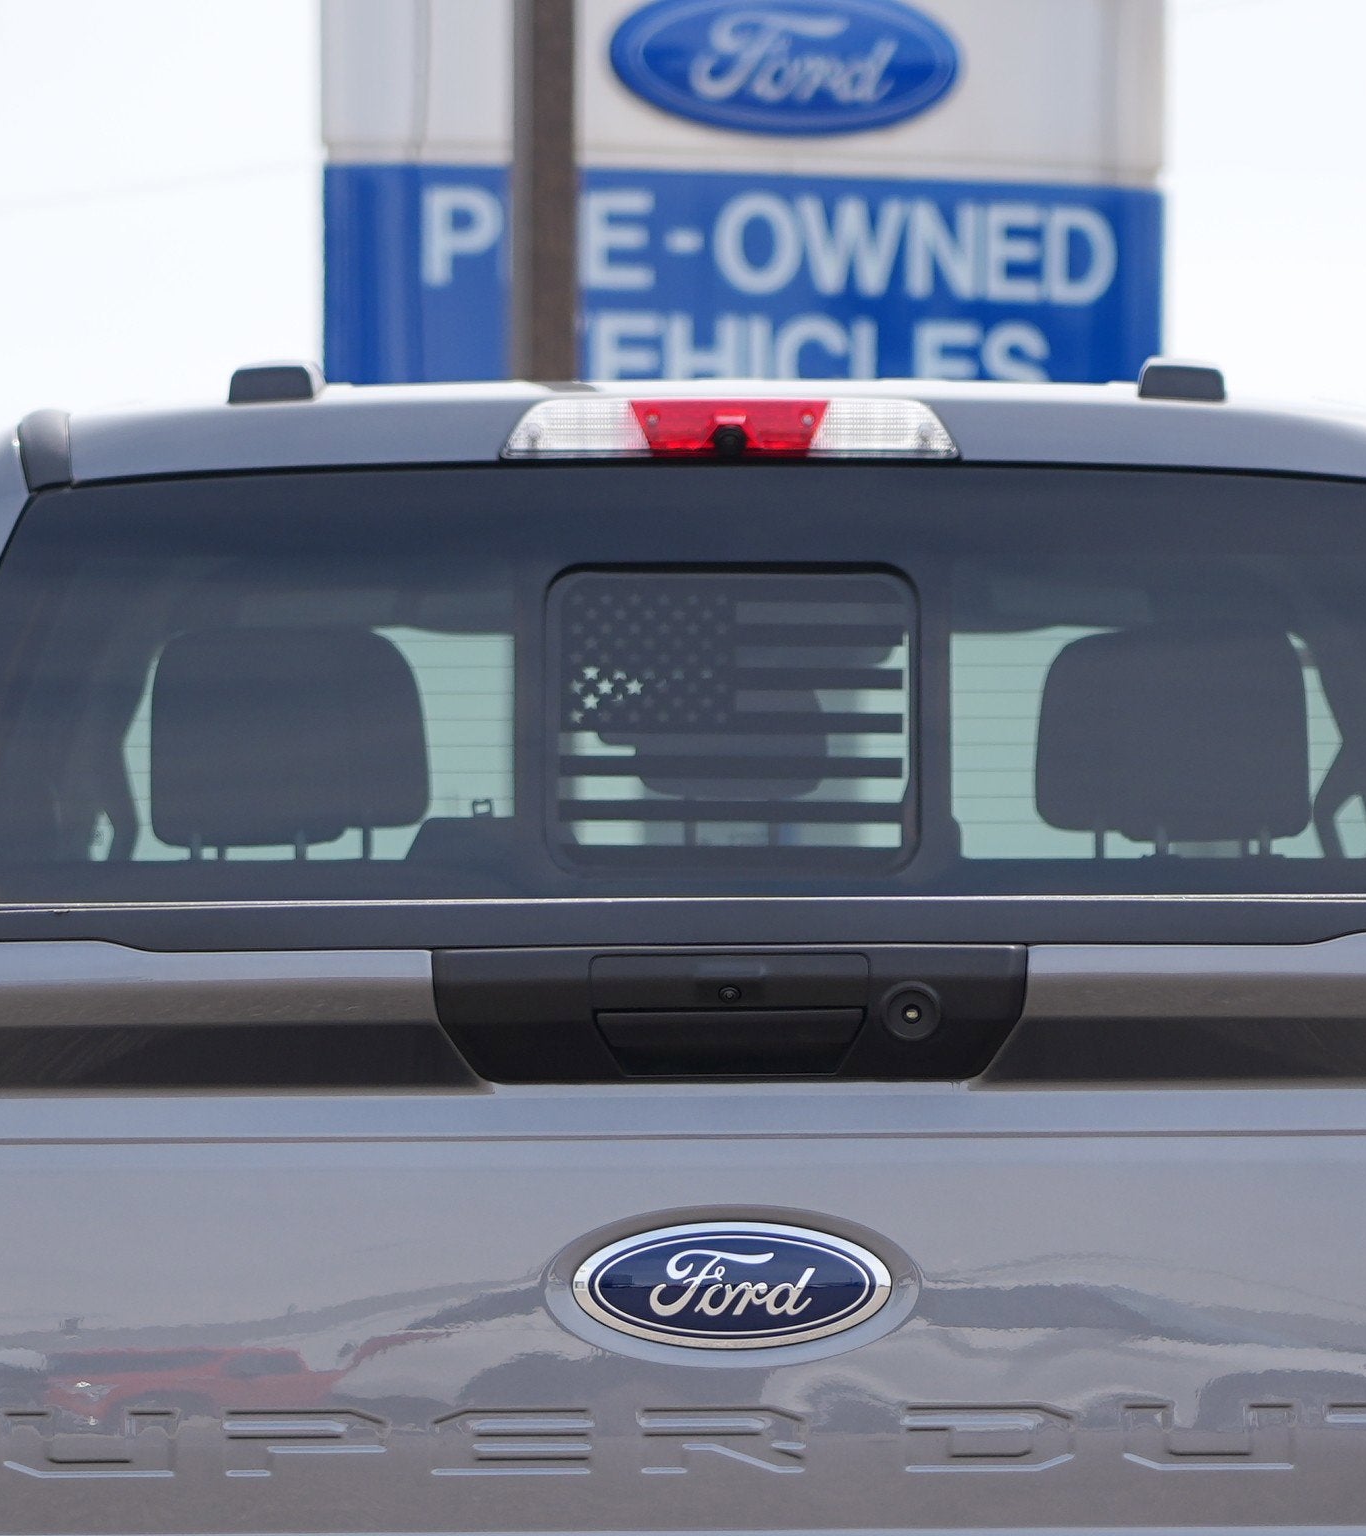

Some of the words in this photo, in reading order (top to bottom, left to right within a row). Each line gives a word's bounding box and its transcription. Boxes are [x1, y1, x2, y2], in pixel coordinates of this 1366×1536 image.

[690, 10, 899, 102] Ford
[421, 185, 1119, 306] PE-OWNED
[579, 312, 1053, 382] EHICLES
[649, 1249, 816, 1316] Ford
